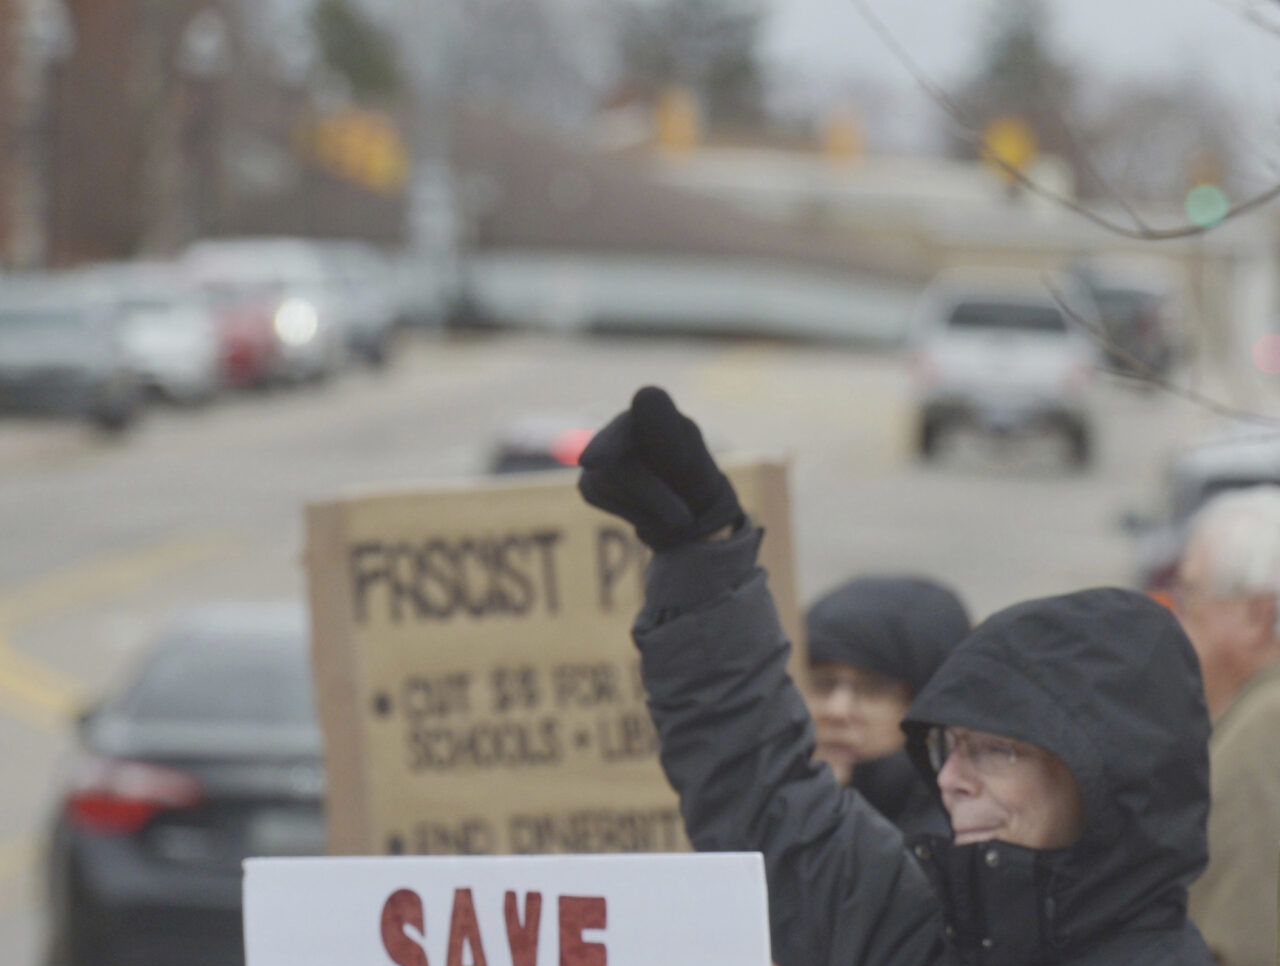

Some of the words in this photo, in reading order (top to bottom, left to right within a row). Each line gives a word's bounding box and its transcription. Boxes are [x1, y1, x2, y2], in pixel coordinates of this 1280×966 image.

[350, 528, 562, 622] FASCIST
[596, 525, 647, 612] P
[407, 716, 563, 771] SCHOOLS
